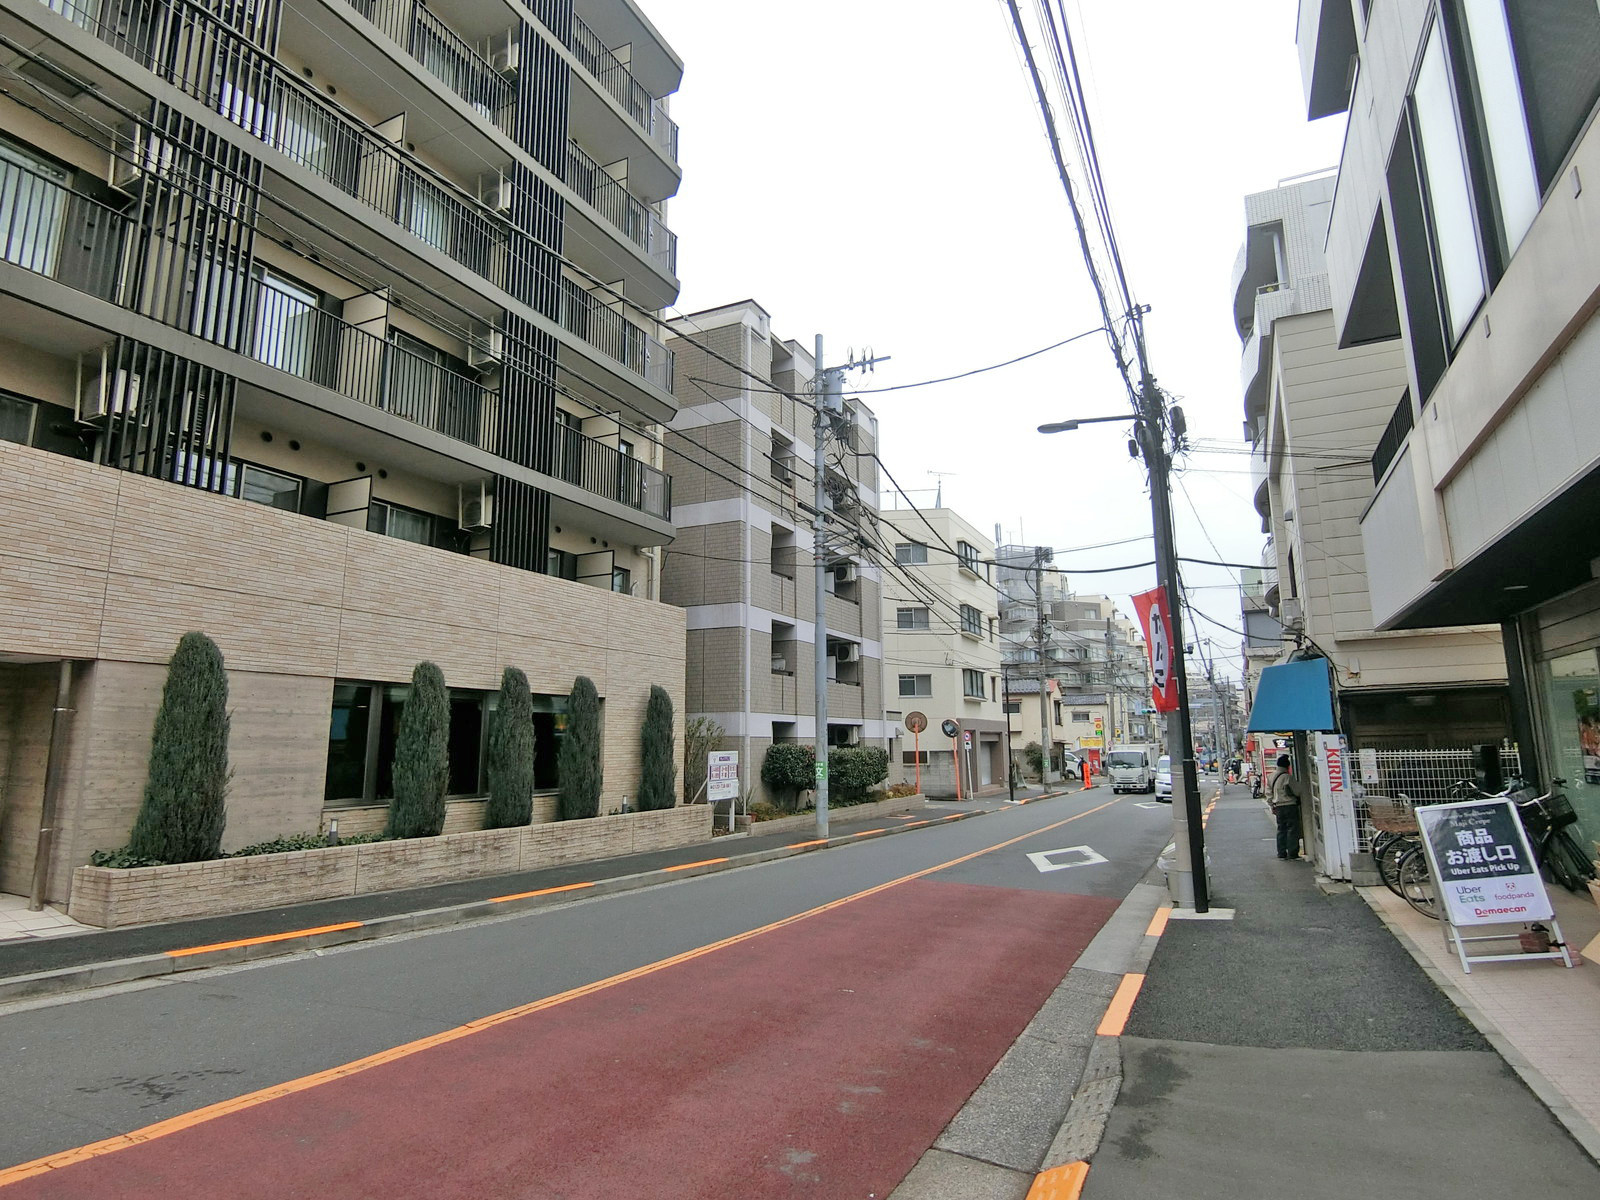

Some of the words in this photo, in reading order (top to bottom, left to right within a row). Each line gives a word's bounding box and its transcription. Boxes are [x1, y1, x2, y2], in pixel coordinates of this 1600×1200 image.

[1327, 748, 1343, 792] KIRIN
[1455, 828, 1494, 846] 商品
[1446, 845, 1516, 865] お渡し口
[1451, 867, 1471, 875] Uber
[1471, 866, 1489, 874] Eats
[1489, 864, 1507, 872] Pick
[1507, 863, 1520, 872] Up
[1456, 885, 1482, 895] Uber
[1494, 891, 1535, 900] foodpanda
[1460, 894, 1486, 904] Eats
[1474, 906, 1527, 917] Demaecan
